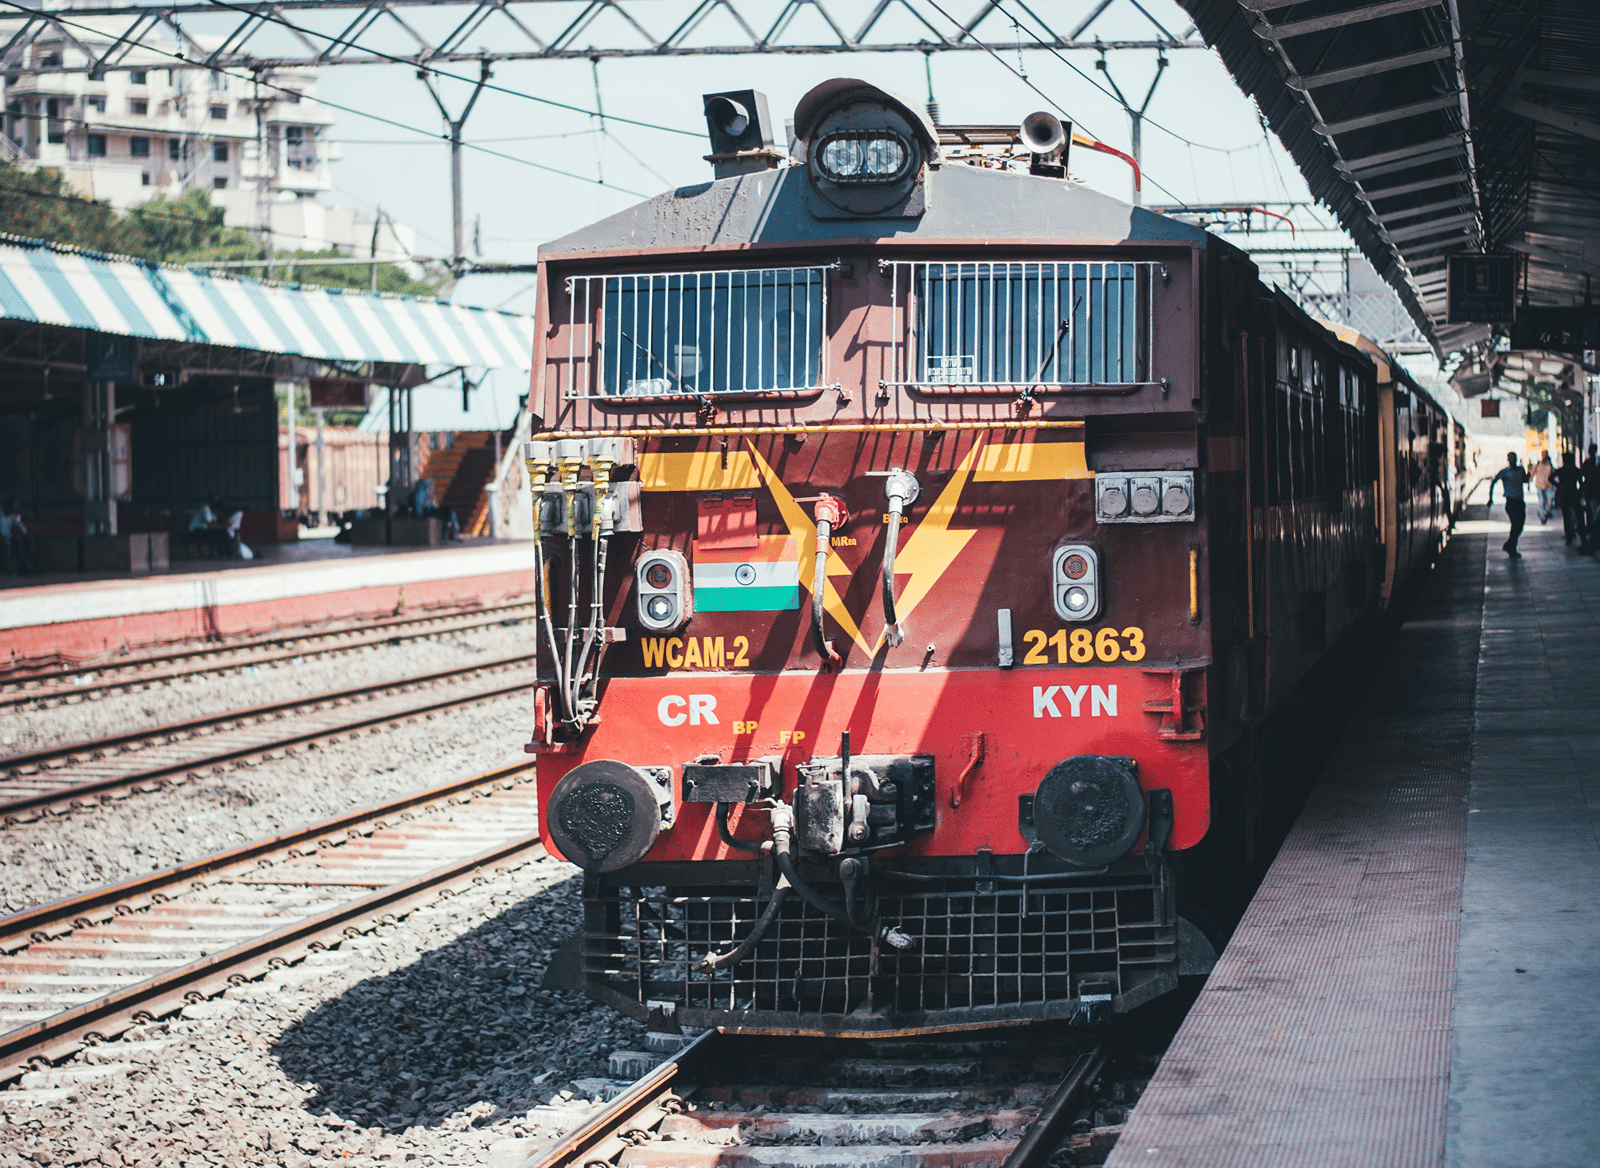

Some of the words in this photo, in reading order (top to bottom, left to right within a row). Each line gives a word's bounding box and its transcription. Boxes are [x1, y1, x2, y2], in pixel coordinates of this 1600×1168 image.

[1452, 312, 1477, 320] COLD
[1480, 312, 1513, 320] WATER
[883, 513, 908, 523] BEQ
[641, 636, 749, 668] WCAM-2
[1023, 626, 1146, 664] 21863
[657, 694, 720, 727] CR
[1032, 684, 1117, 718] KYN
[732, 721, 758, 735] BP
[779, 730, 805, 744] FP
